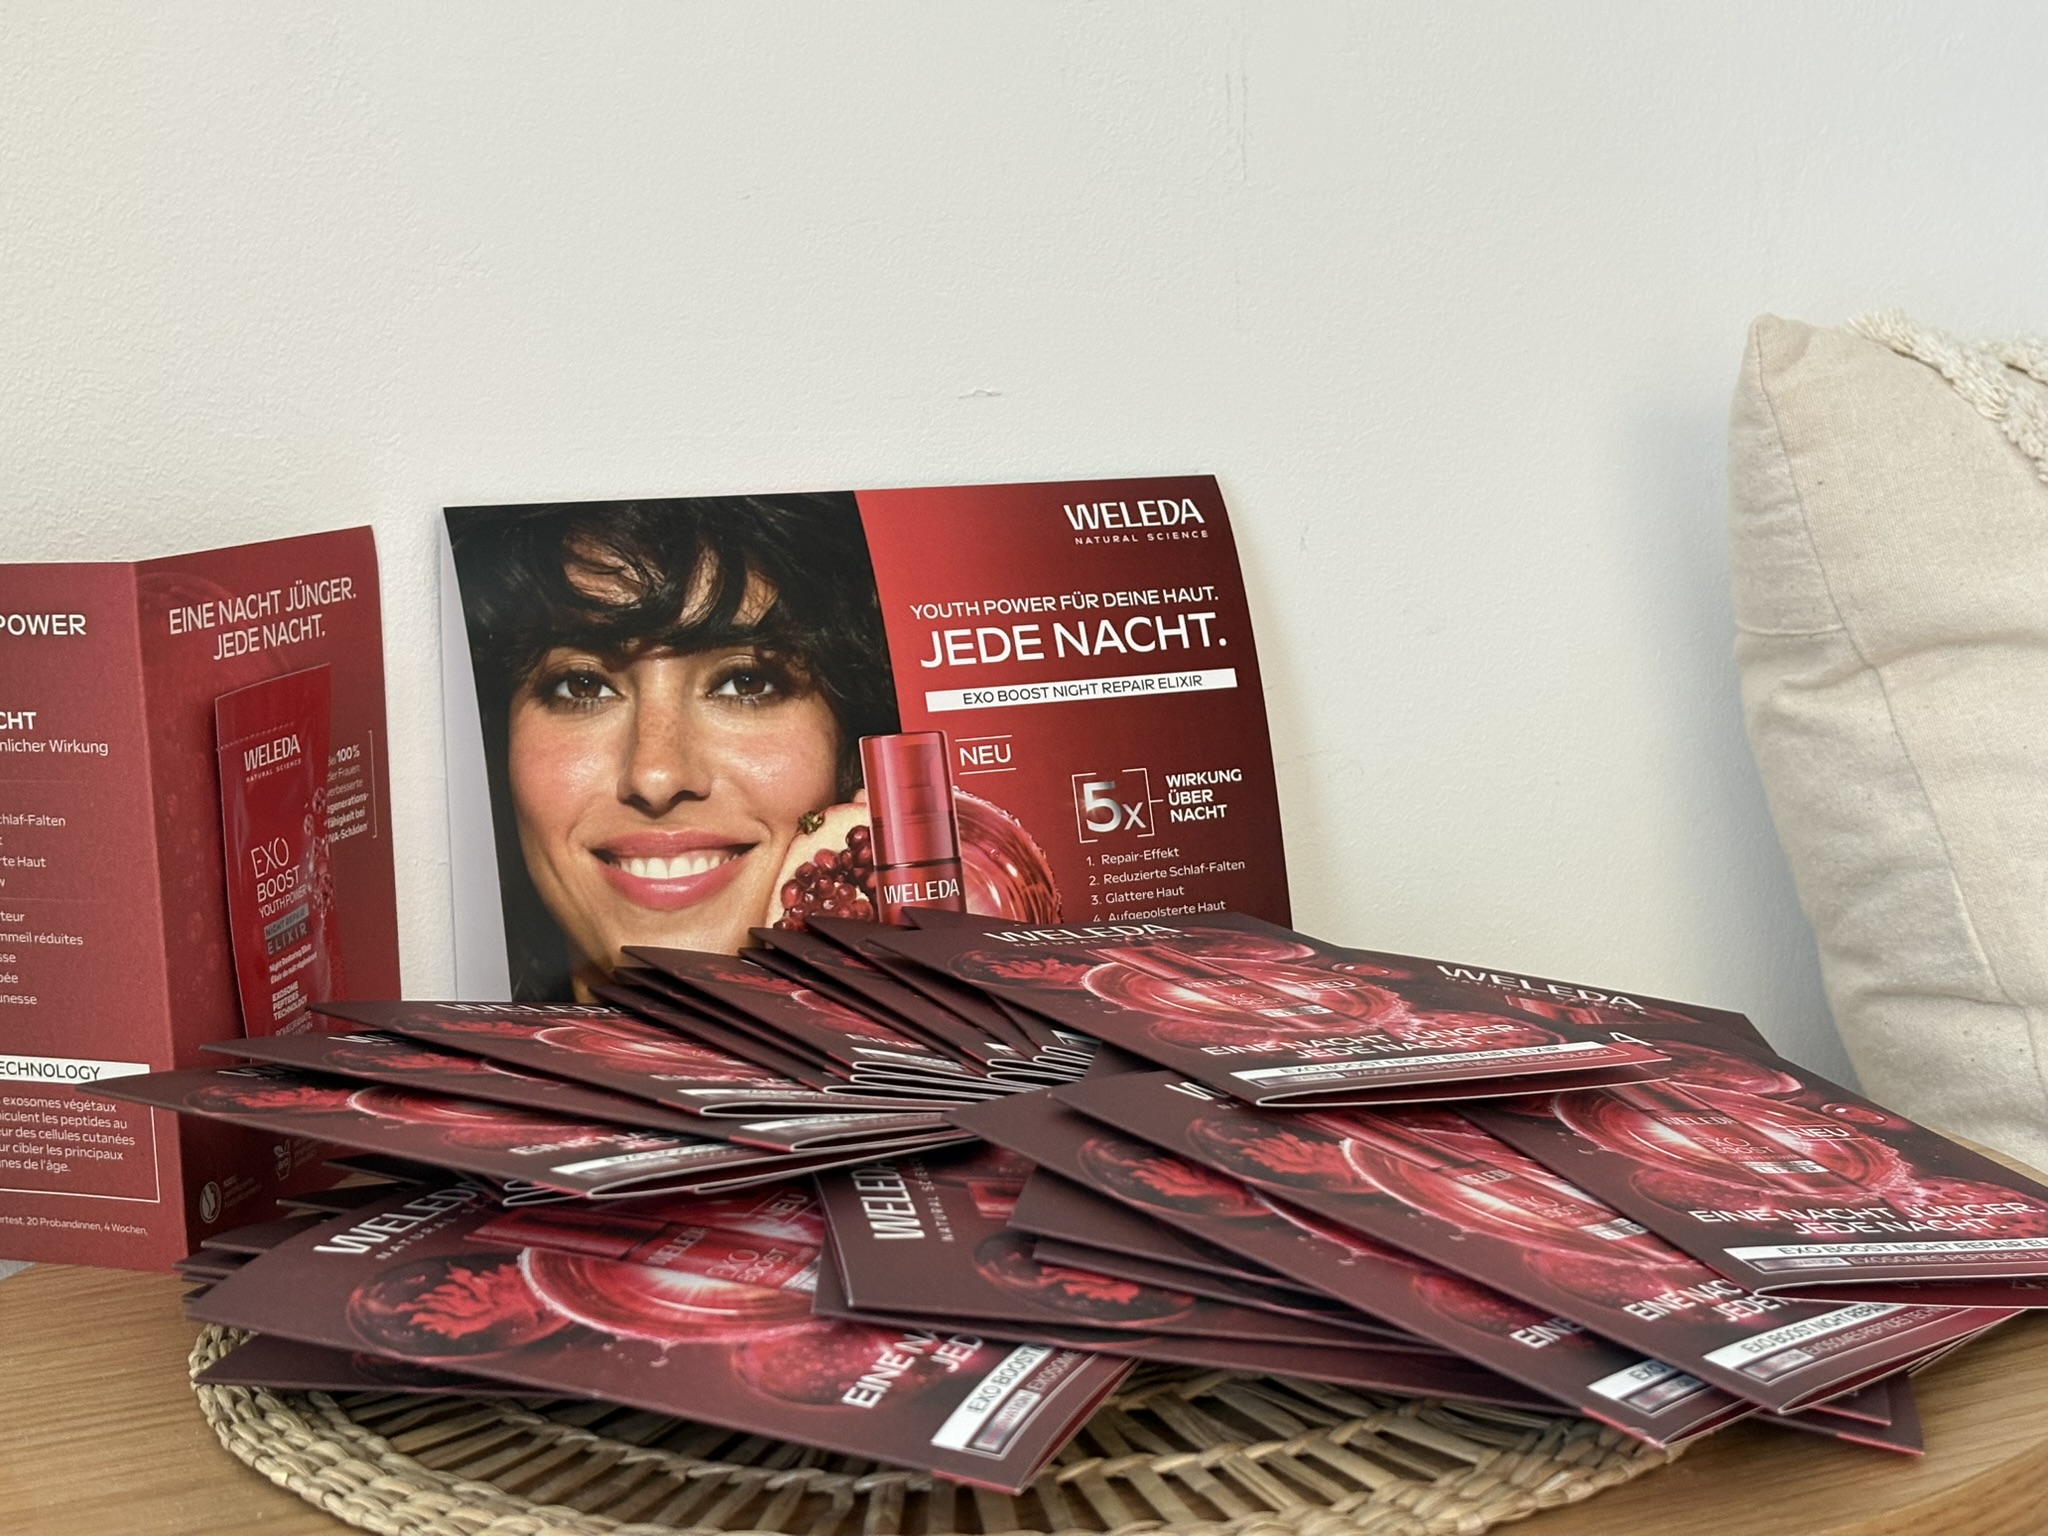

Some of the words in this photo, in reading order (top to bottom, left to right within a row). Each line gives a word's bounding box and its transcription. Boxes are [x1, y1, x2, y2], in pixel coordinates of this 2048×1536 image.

[1063, 498, 1205, 531] WELEDA
[1074, 534, 1139, 546] NATURAL
[1147, 529, 1209, 542] SCIENCE
[169, 601, 215, 635] EINE
[217, 589, 282, 623] NACHT
[285, 576, 357, 612] JÜNGER.
[909, 600, 981, 620] YOUTH
[983, 596, 1058, 616] POWER
[1060, 591, 1099, 611] FÜR
[1102, 589, 1161, 608] DEINE
[1162, 585, 1219, 604] HAUT.
[213, 629, 260, 661] JEDE
[263, 613, 326, 650] NACHT.
[920, 623, 1045, 669] JEDE
[1052, 611, 1228, 660] NACHT.
[962, 690, 995, 706] EXO
[996, 686, 1051, 704] BOOST
[1052, 682, 1099, 699] NIGHT
[1101, 678, 1156, 695] REPAIR
[1157, 674, 1204, 690] ELIXIR
[48, 739, 109, 757] Wirkung
[243, 734, 302, 772] WELEDA
[336, 744, 360, 763] 100%
[958, 742, 1013, 767] NEU
[1165, 768, 1243, 790] WIRKUNG
[1082, 780, 1147, 833] 5x
[1168, 788, 1214, 807] ÜBER
[1170, 804, 1229, 824] NACHT
[17, 856, 47, 868] Haut
[250, 837, 289, 879] EXO
[1086, 855, 1096, 868] 1.
[1101, 847, 1180, 867] Repair-Effekt
[257, 865, 301, 904] BOOST
[1088, 875, 1100, 887] 2.
[1103, 867, 1168, 886] Reduzierte
[1169, 859, 1246, 879] Schlaf-Falten
[884, 878, 961, 904] WELEDA
[1090, 894, 1102, 906] 3.
[1105, 889, 1155, 904] Glattere
[1155, 885, 1185, 900] Haut
[258, 897, 286, 919] YOUTH
[1108, 904, 1198, 922] Aufgepolsterte
[1197, 899, 1227, 914] Haut
[34, 933, 84, 945] réduites
[267, 922, 308, 956] ELIXIR
[982, 923, 1182, 943] WELEDA
[1436, 964, 1646, 1010] WELEDA
[1199, 1042, 1273, 1056] EINE
[1280, 1034, 1392, 1050] NACHT
[1296, 1045, 1377, 1059] JEDE
[1376, 1036, 1493, 1054] NACHT.
[3, 1096, 61, 1109] exosomes
[63, 1098, 117, 1113] végétaux
[42, 1111, 59, 1124] les
[60, 1115, 111, 1128] peptides
[113, 1119, 128, 1130] au
[1658, 1115, 1739, 1126] WELEDA
[1786, 1126, 1851, 1138] NEU
[15, 1126, 37, 1139] des
[38, 1129, 81, 1142] cellules
[82, 1133, 136, 1146] cutanées
[12, 1142, 44, 1155] cibler
[46, 1144, 62, 1156] les
[65, 1147, 124, 1161] principaux
[23, 1158, 38, 1170] de
[313, 1181, 482, 1254] WELEDA
[1687, 1209, 1779, 1223] EINE
[1774, 1207, 1896, 1221] NACHT
[1904, 1202, 2046, 1218] JÜNGER.
[27, 1216, 38, 1225] 20
[40, 1217, 103, 1232] Probandinnen,
[104, 1222, 111, 1231] 4
[112, 1222, 149, 1236] Wochen,
[1793, 1221, 1883, 1234] JEDE
[1877, 1218, 2008, 1233] NACHT.
[1777, 1246, 1822, 1256] EXO
[1822, 1243, 1893, 1255] BOOST
[1894, 1242, 1954, 1252] NIGHT
[1955, 1239, 2025, 1250] REPAIR
[1622, 1290, 1697, 1322] EINE
[1677, 1278, 1743, 1304] NAC
[1711, 1296, 1782, 1322] JEDE
[1509, 1316, 1585, 1349] EINE
[1773, 1322, 1816, 1345] BOOST
[929, 1334, 984, 1373] JED
[842, 1350, 917, 1409] EINE
[966, 1384, 1002, 1414] EXO
[993, 1349, 1040, 1386] BOOST
